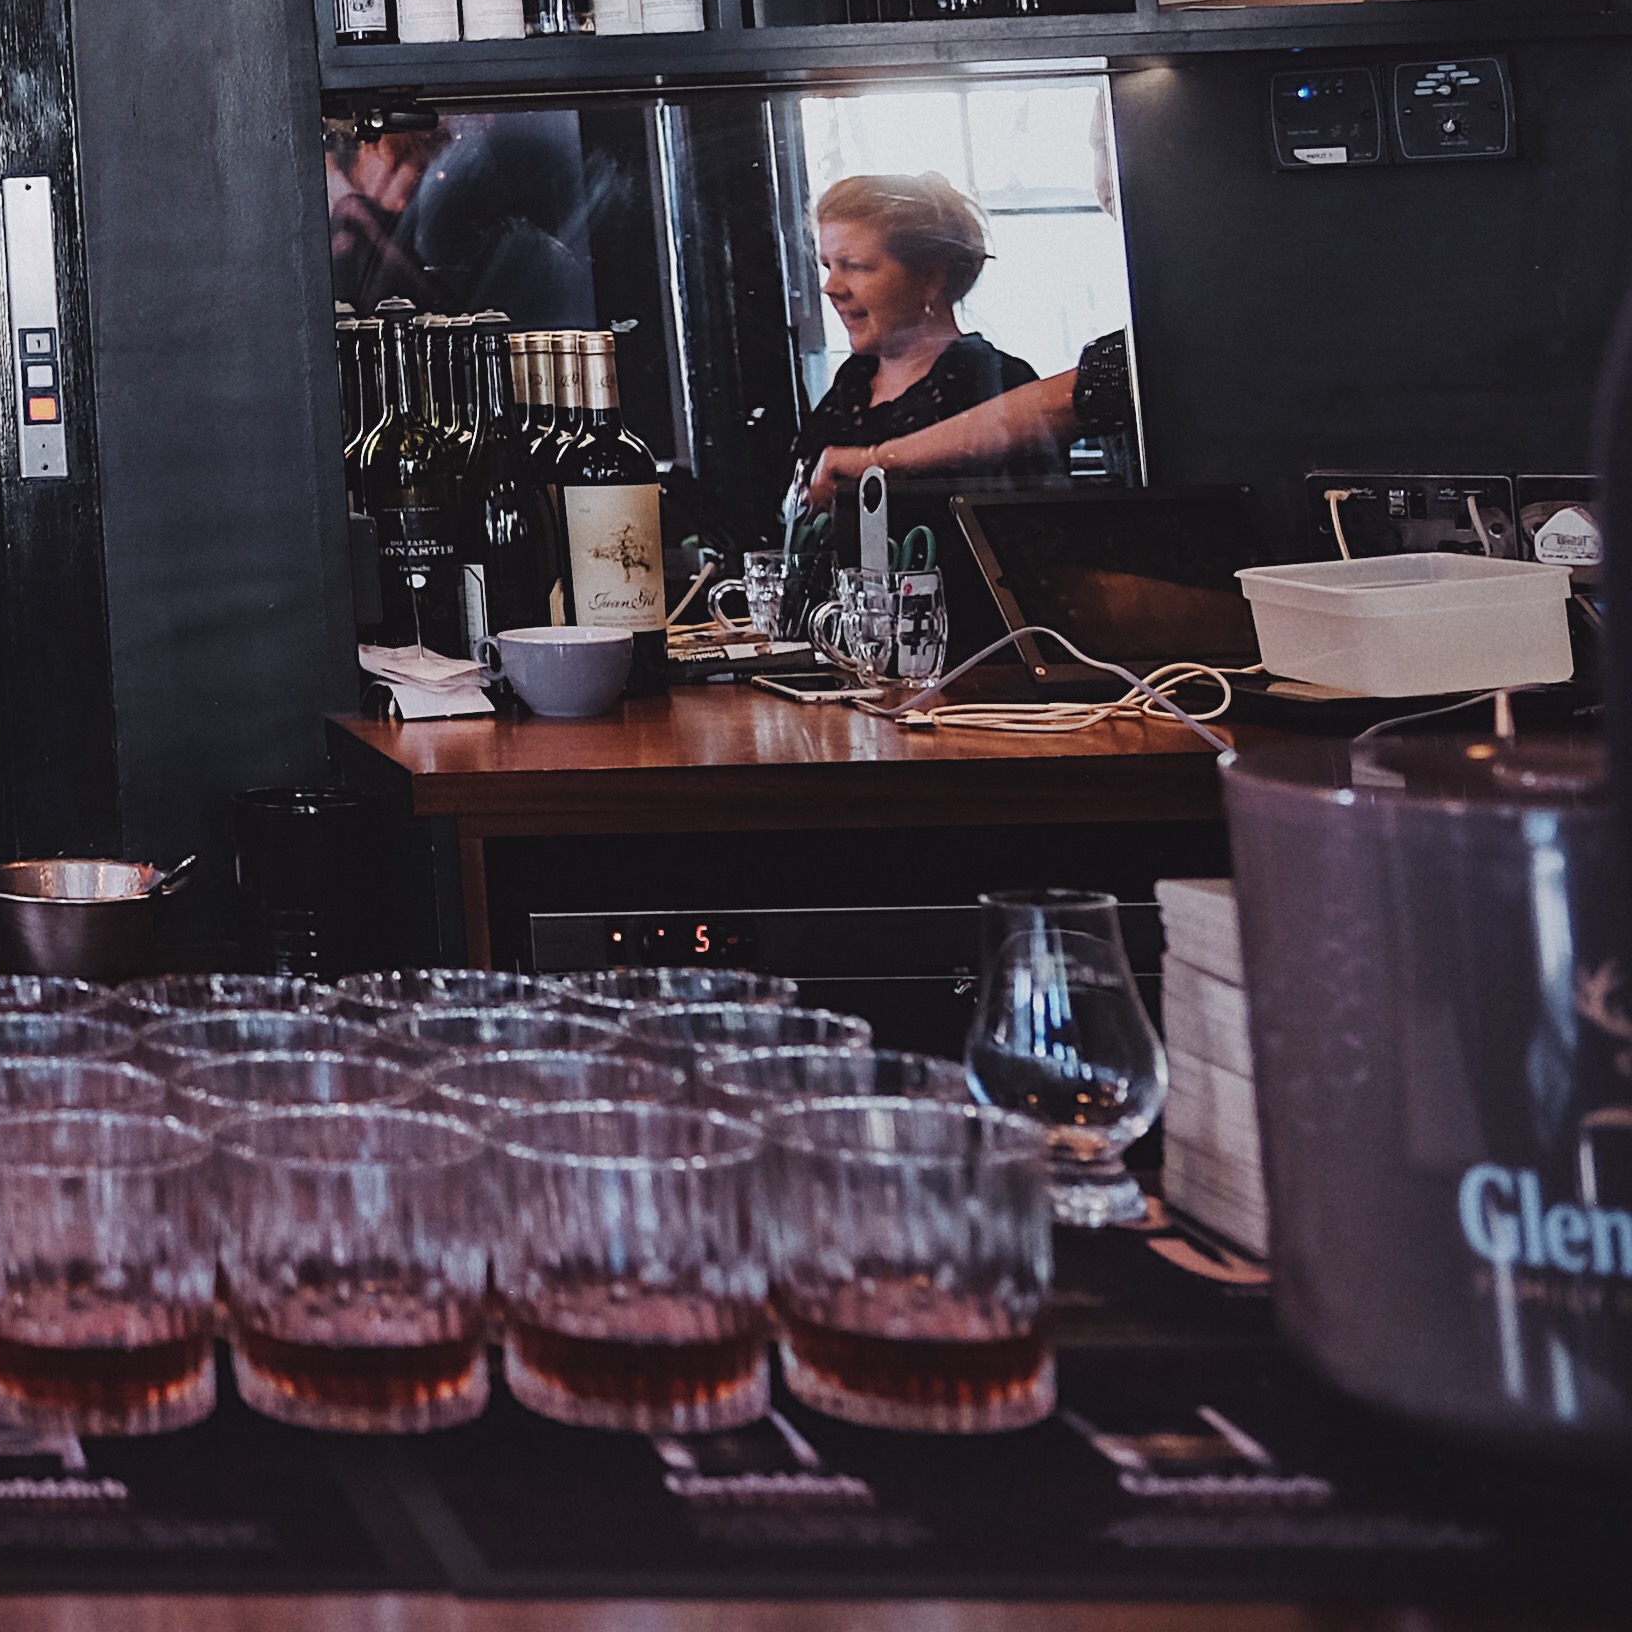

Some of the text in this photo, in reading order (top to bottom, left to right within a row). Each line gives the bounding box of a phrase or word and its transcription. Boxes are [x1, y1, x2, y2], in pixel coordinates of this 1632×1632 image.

[36, 339, 41, 349] 1
[588, 587, 657, 612] Juan Gil
[695, 924, 710, 953] 5
